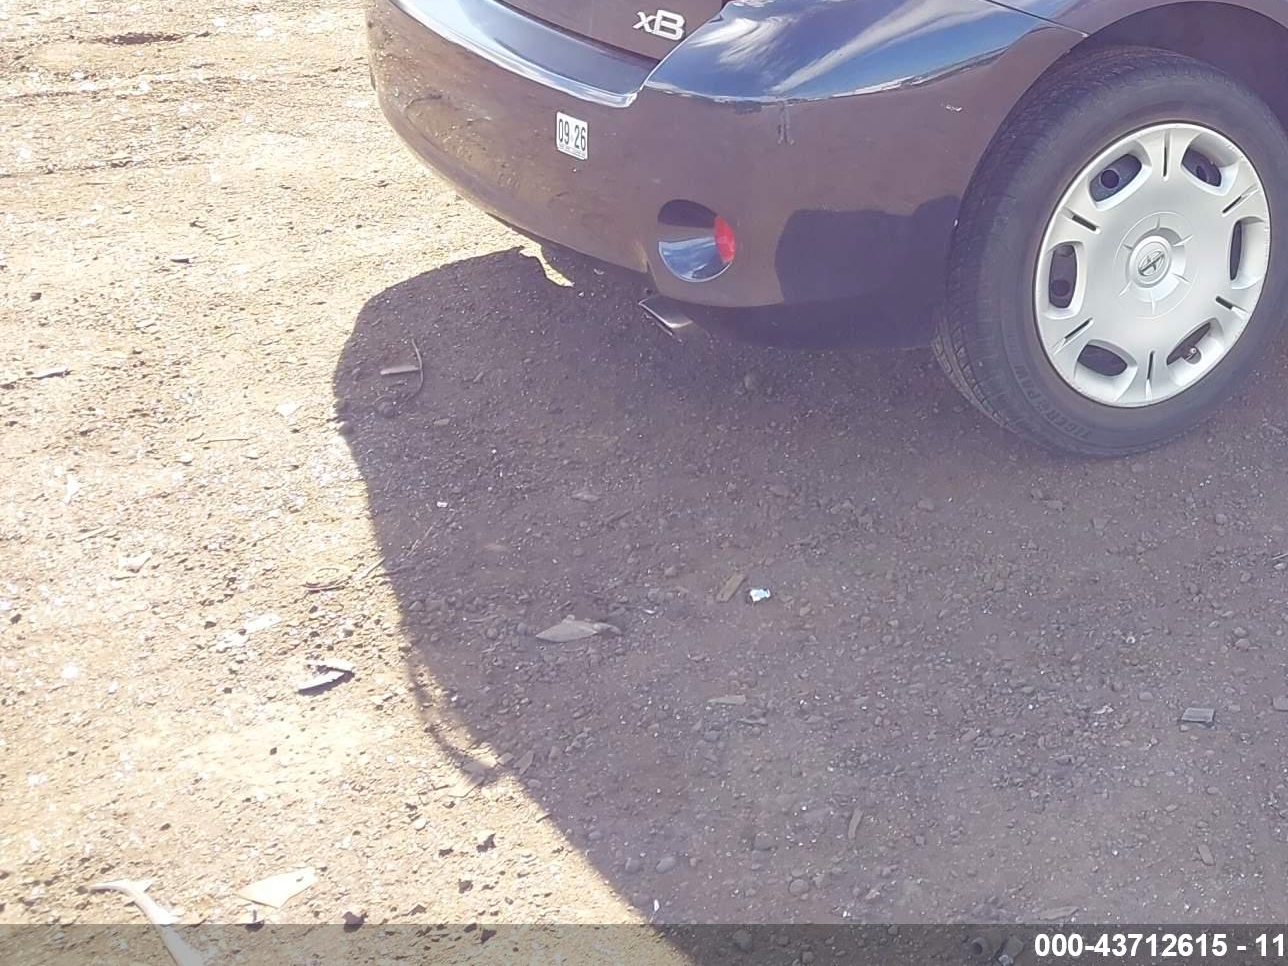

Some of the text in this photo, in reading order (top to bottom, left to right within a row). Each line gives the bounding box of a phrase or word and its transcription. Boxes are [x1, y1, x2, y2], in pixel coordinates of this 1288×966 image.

[632, 9, 685, 41] xB
[558, 118, 570, 145] 09
[574, 124, 586, 151] 26
